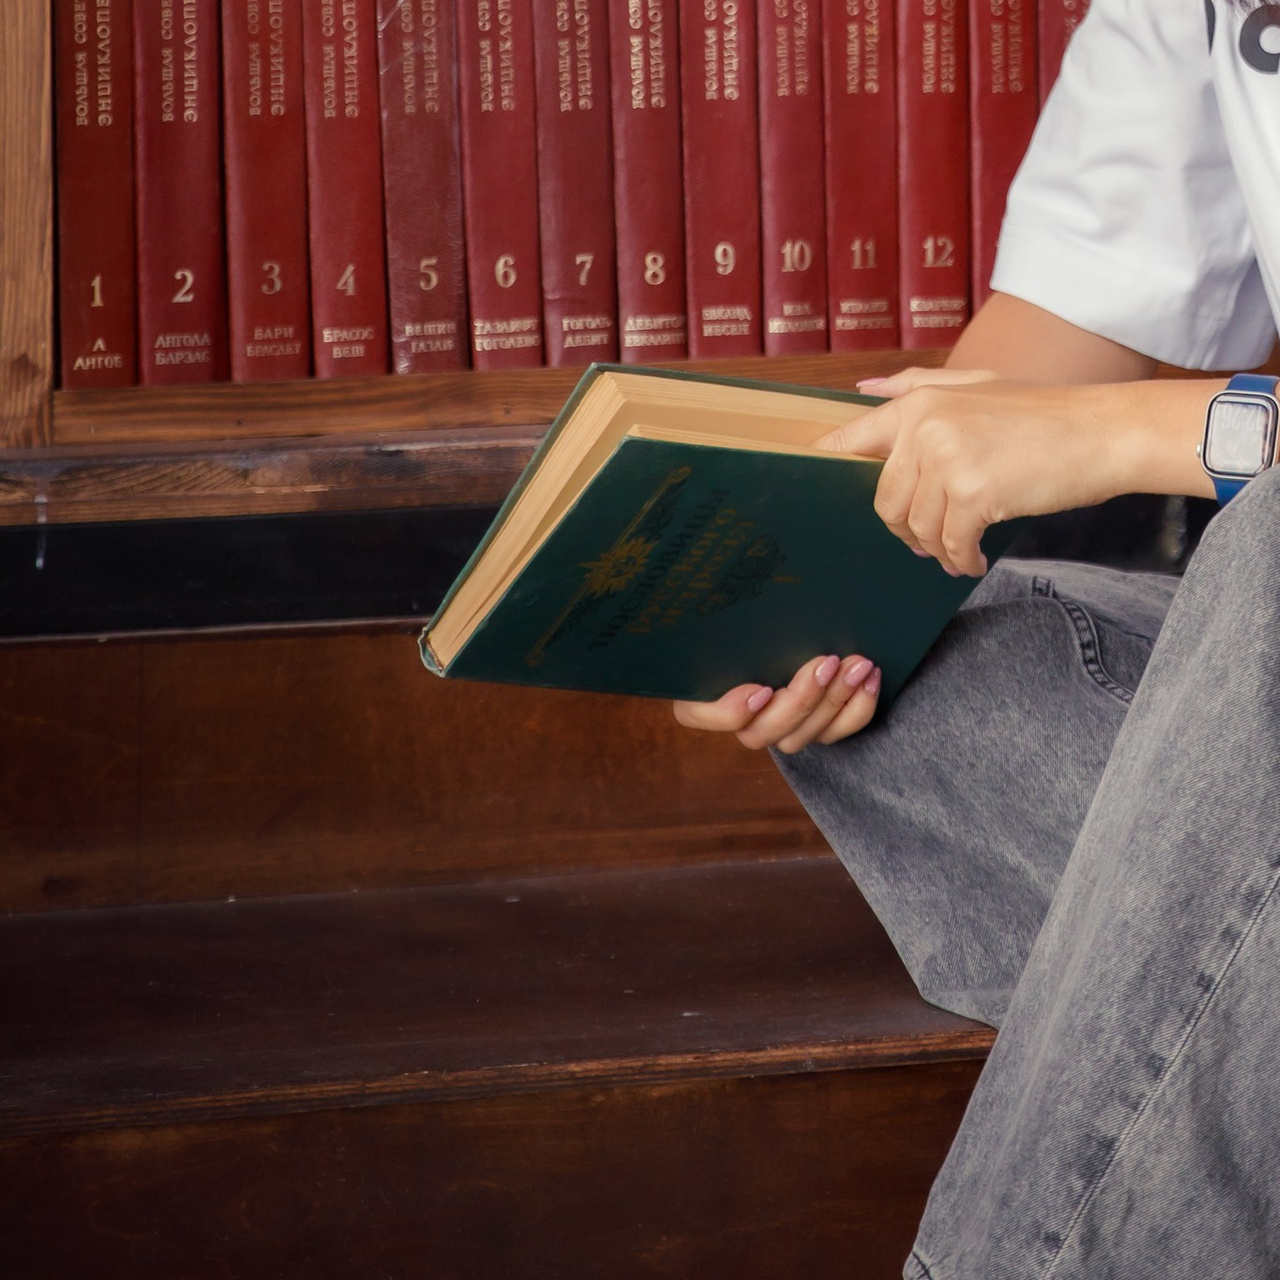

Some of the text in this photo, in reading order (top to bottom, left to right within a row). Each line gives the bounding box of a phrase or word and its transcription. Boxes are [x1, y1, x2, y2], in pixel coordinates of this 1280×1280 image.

[248, 42, 262, 116] БОЛЬШАЯ
[479, 39, 494, 112] БОЛЬШАЯ
[557, 38, 573, 112] БОЛЬШАЯ
[629, 35, 645, 109] БОЛЬШАЯ
[704, 27, 719, 101] БОЛЬШАЯ
[75, 51, 89, 126] БОЛЬШАЯ
[161, 47, 175, 122] БОЛЬШАЯ
[322, 44, 337, 118] БОЛЬШАЯ
[643, 251, 665, 286] 8
[714, 242, 735, 276] 9
[780, 240, 811, 273] 10
[850, 238, 875, 270] 11
[922, 236, 954, 268] 12
[172, 269, 194, 303] 2
[261, 261, 283, 295] 3
[335, 263, 355, 296] 4
[419, 257, 439, 291] 5
[494, 255, 517, 288] 6
[575, 253, 594, 286] 7
[91, 275, 104, 307] 1
[92, 337, 107, 354] А
[154, 331, 213, 349] АНГОЛА
[246, 341, 302, 358] БРАСЛЕТ
[253, 326, 295, 342] БАРИ
[322, 326, 375, 344] БРАСОС
[73, 352, 124, 371] АНГОБ
[154, 349, 211, 366] БАРЗАС
[331, 344, 366, 360] ВЕШ
